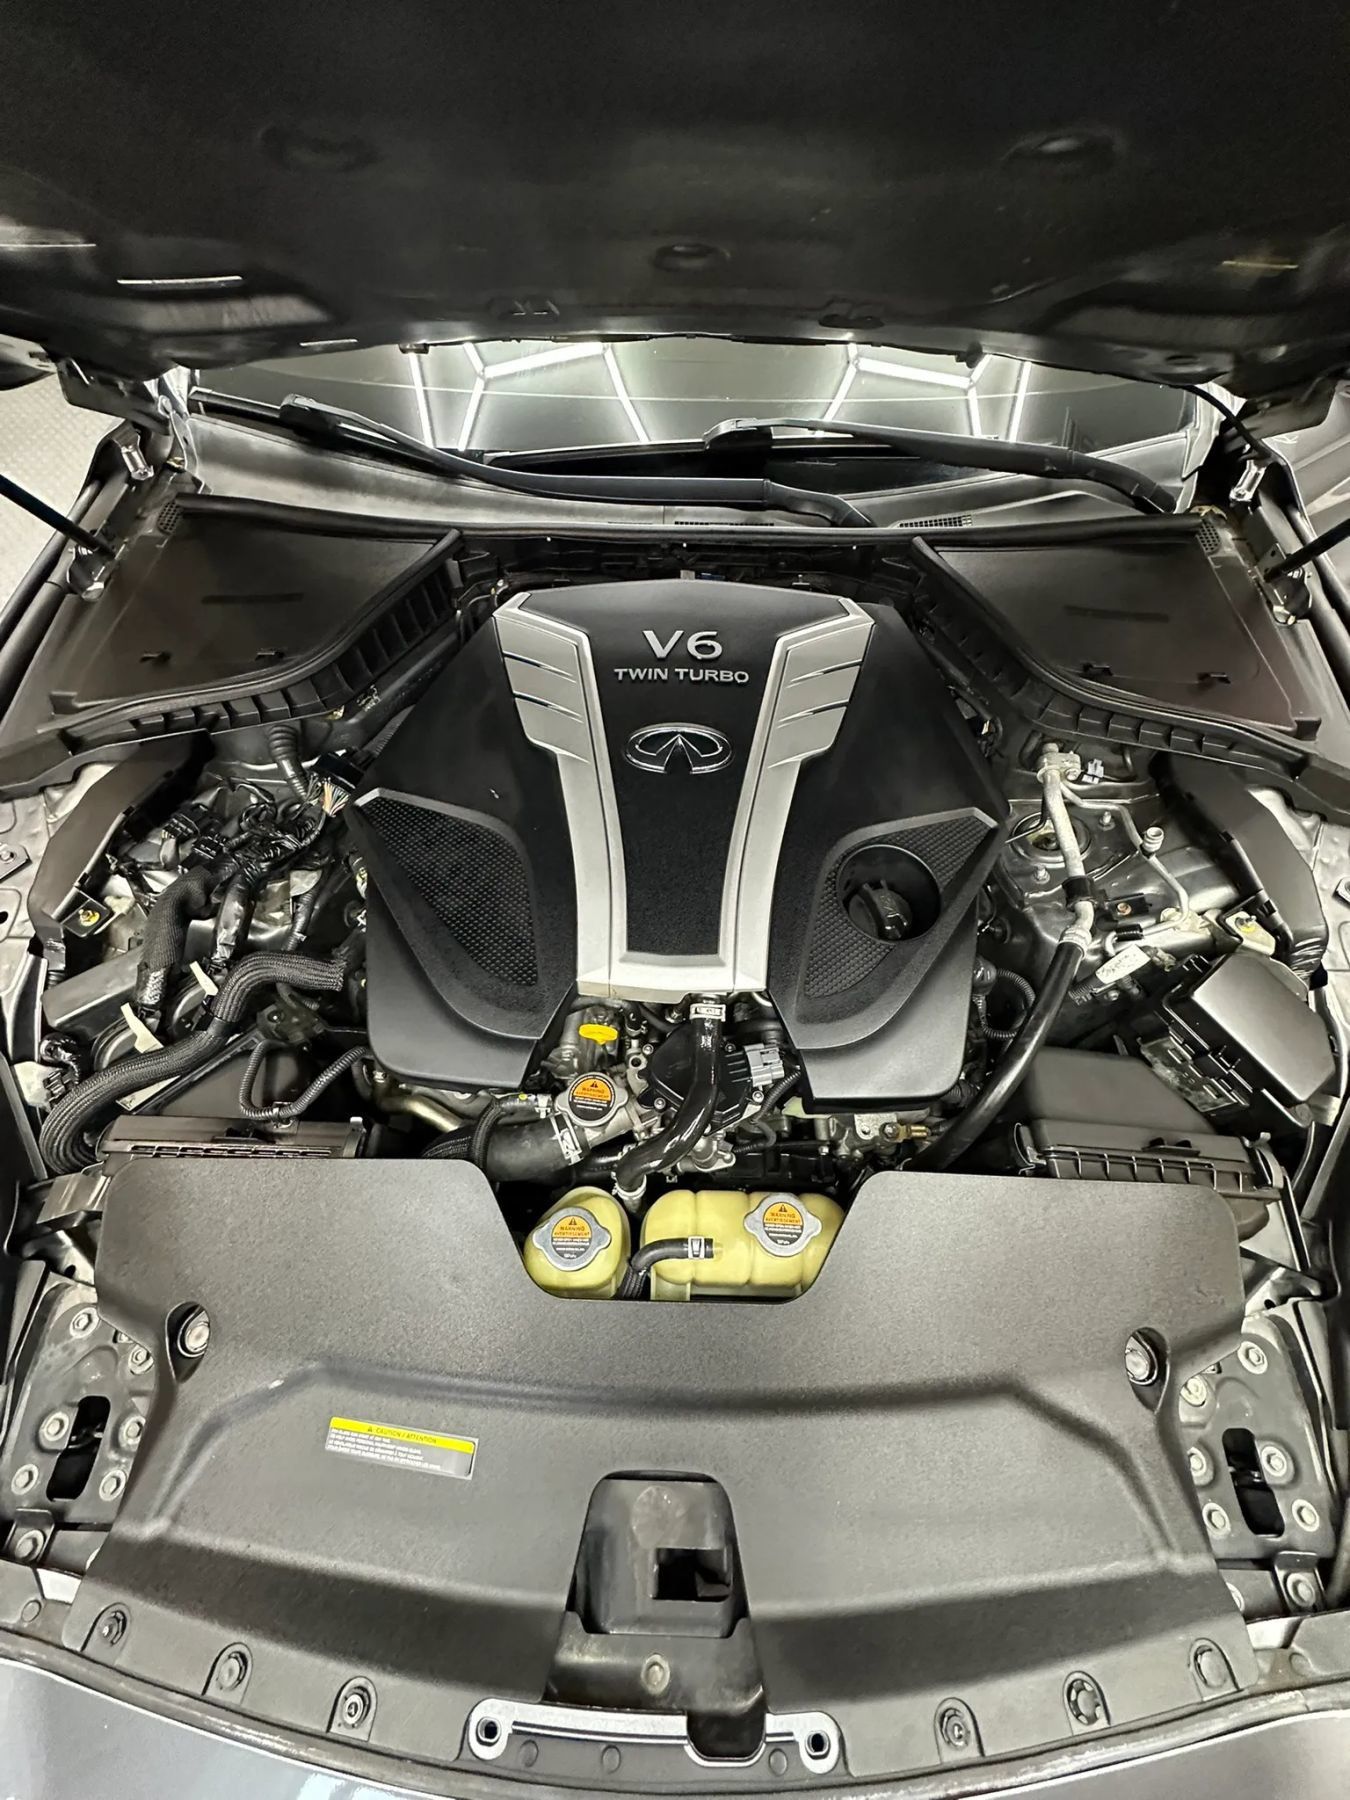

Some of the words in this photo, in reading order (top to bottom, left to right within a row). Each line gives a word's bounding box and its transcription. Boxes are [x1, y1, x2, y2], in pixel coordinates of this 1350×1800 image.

[643, 630, 723, 660] V6
[614, 668, 668, 681] TWIN
[675, 668, 749, 684] TURBO
[375, 1427, 401, 1437] CAUTION
[406, 1433, 437, 1444] ATTENTION
